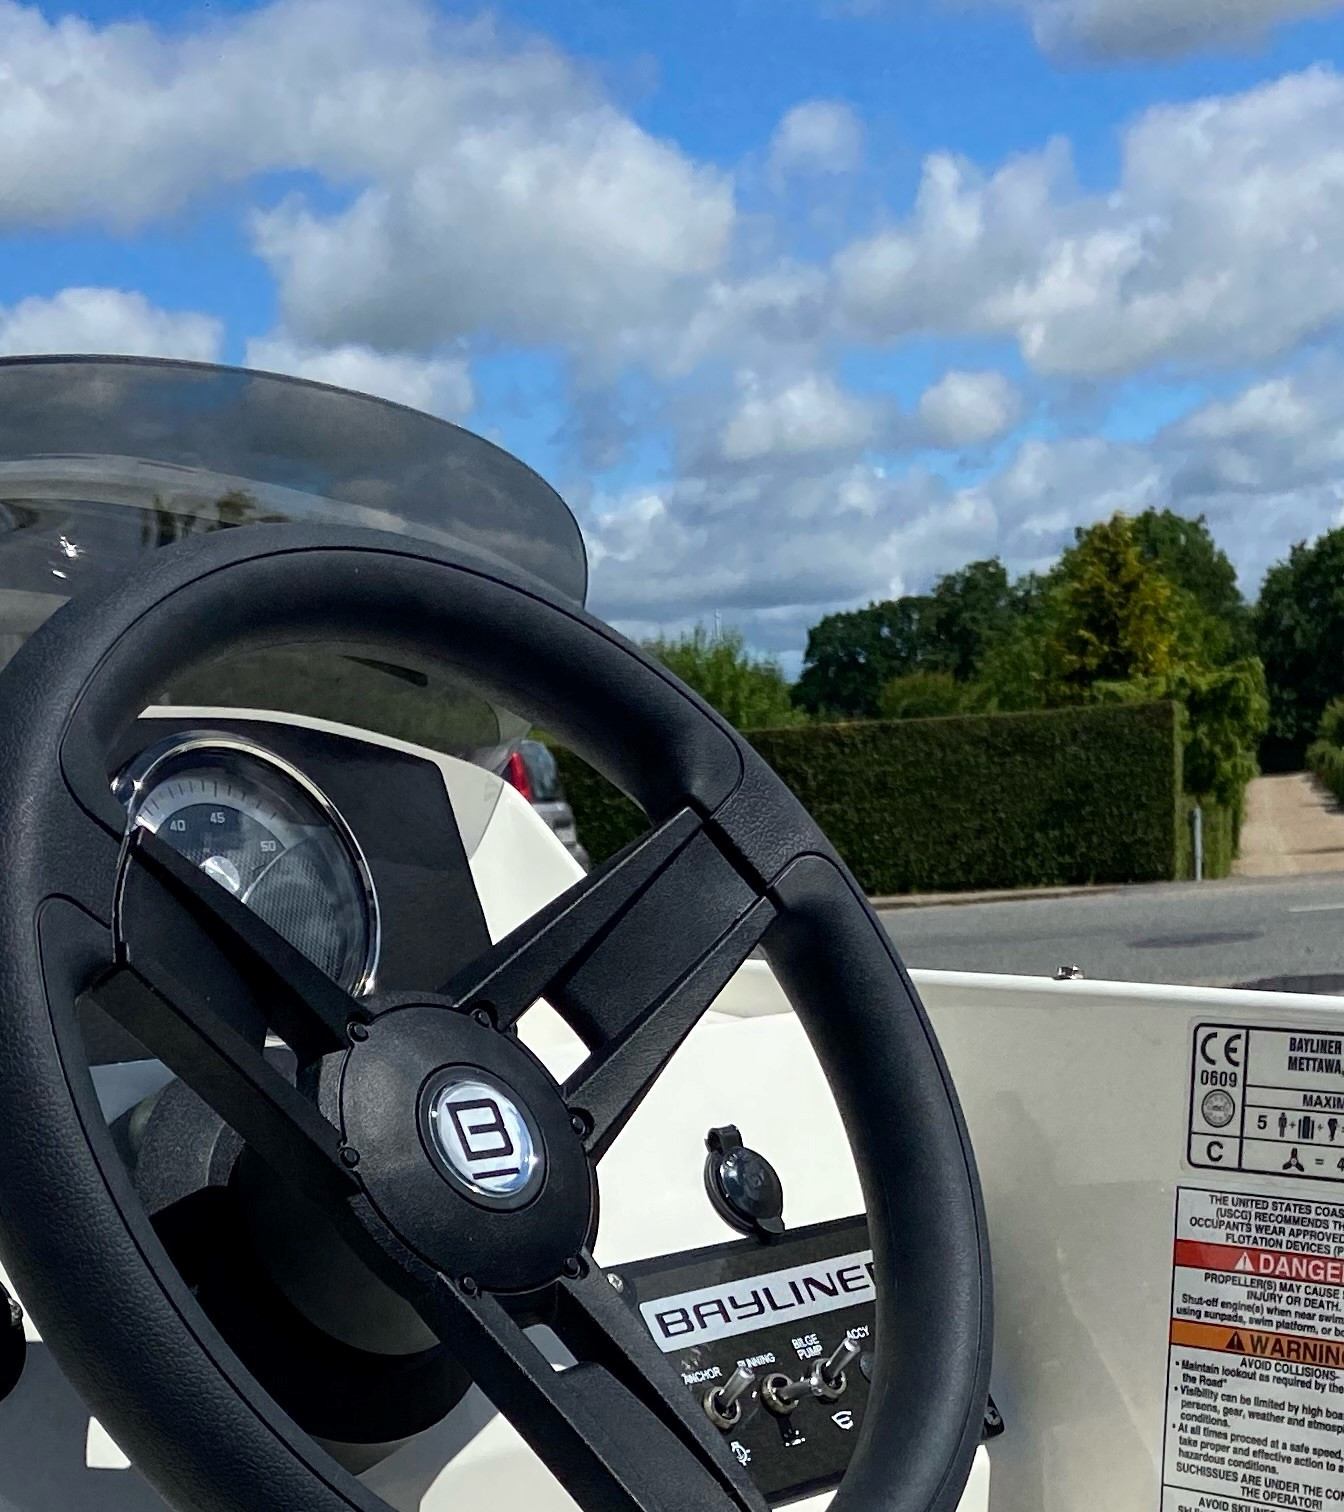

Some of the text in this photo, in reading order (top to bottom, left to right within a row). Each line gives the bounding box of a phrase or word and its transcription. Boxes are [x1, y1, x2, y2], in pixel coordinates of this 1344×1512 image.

[170, 820, 186, 832] 40
[210, 811, 226, 824] 45
[260, 840, 276, 852] 50
[1289, 1036, 1342, 1055] BAYLINER
[1200, 1069, 1238, 1088] 0609
[1257, 1114, 1268, 1130] 5
[1208, 1194, 1229, 1206] THE
[1231, 1196, 1269, 1210] UNITED
[1271, 1201, 1312, 1215] STATES
[1189, 1216, 1252, 1233] OCCUPANTS
[1254, 1223, 1286, 1237] WEAR
[1215, 1207, 1252, 1222] (USCG)
[1254, 1211, 1329, 1230] RECOMMENDS
[1246, 1290, 1283, 1304] INJURY
[1285, 1295, 1301, 1307] OR
[1278, 1281, 1302, 1294] MAY
[1304, 1284, 1340, 1300] CAUSE
[654, 1261, 875, 1338] BAYLINE
[791, 1333, 820, 1350] BILGE
[846, 1325, 870, 1341] ACCY
[797, 1344, 823, 1361] PUMP
[1239, 1357, 1272, 1371] AVOID
[1239, 1485, 1260, 1499] THE
[1240, 1473, 1262, 1487] ARE
[1264, 1476, 1300, 1494] UNDER
[1301, 1483, 1323, 1498] THE
[1198, 1496, 1229, 1512] AVOID
